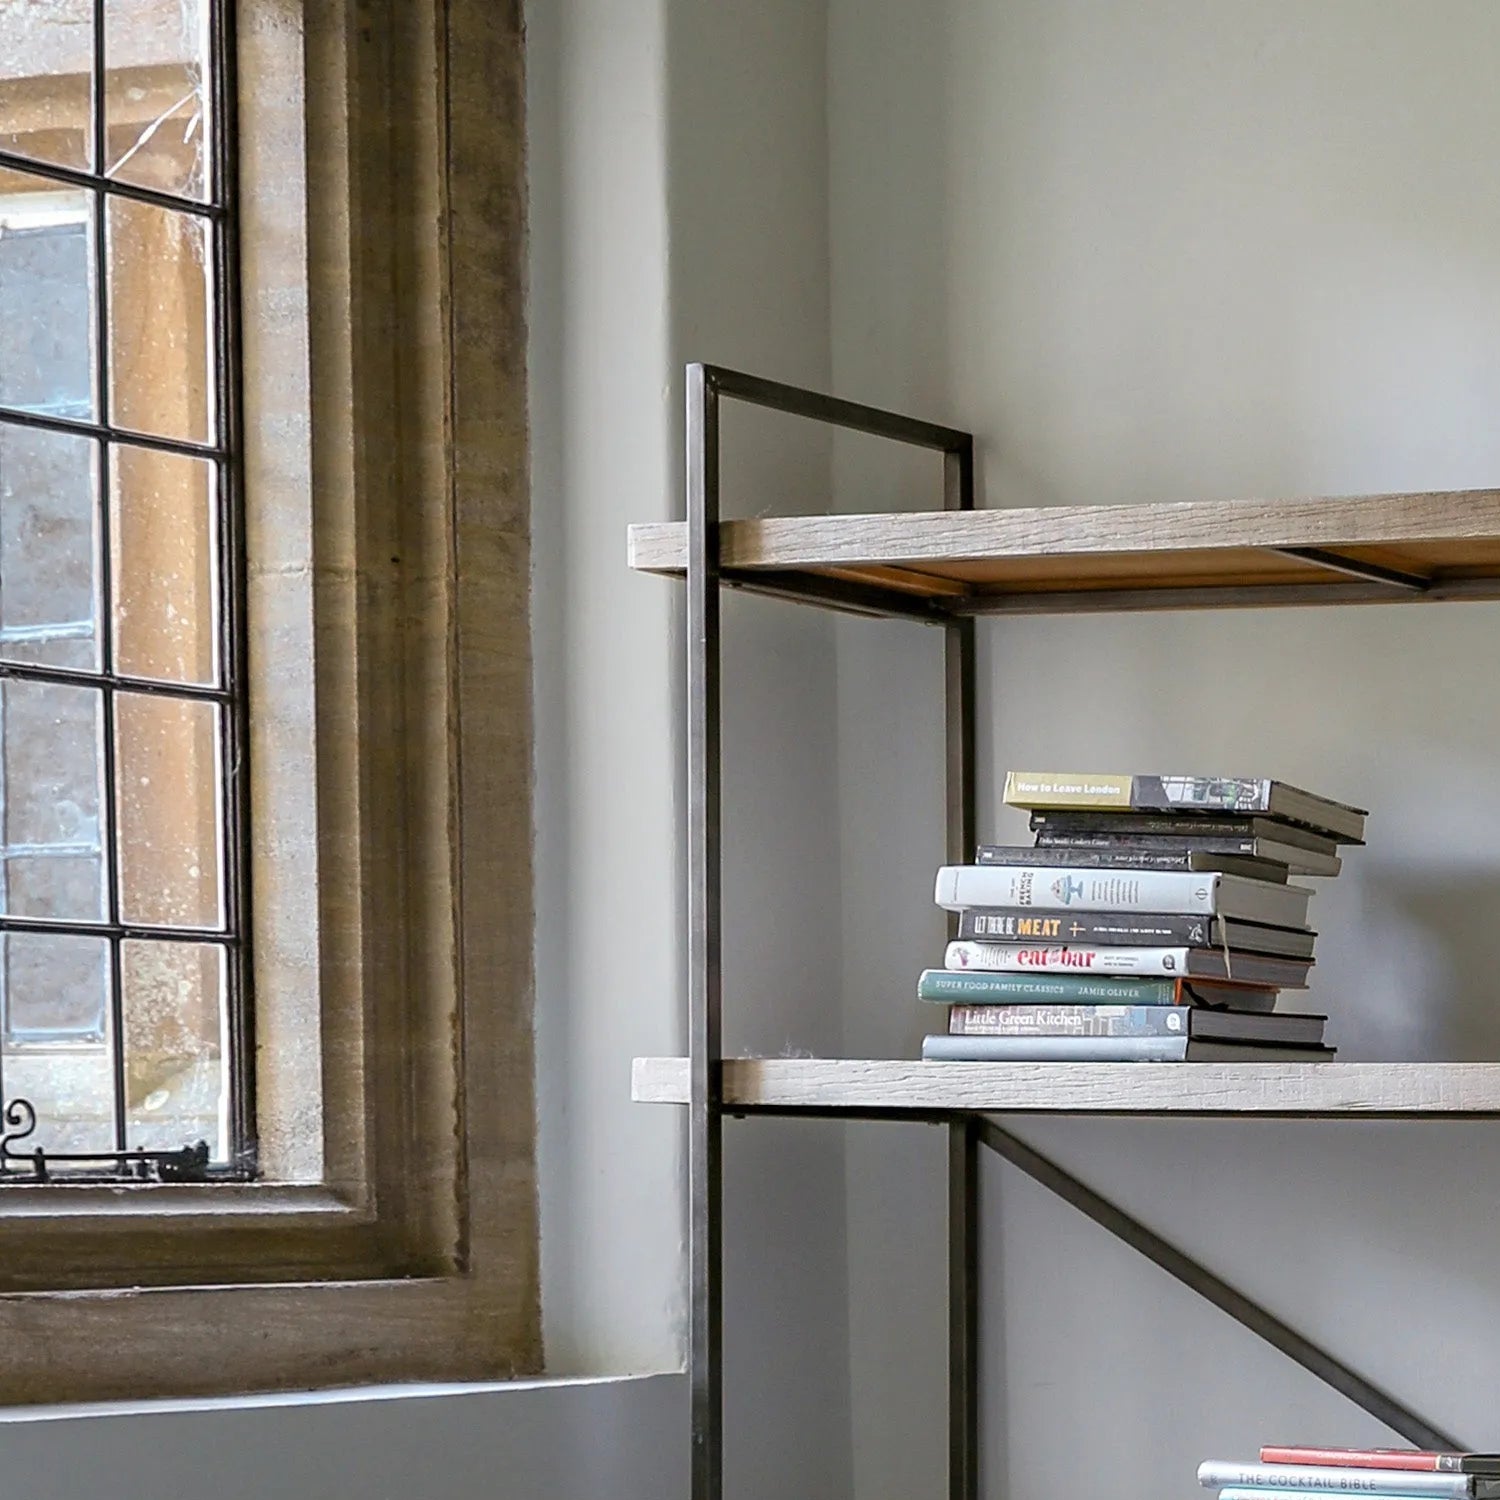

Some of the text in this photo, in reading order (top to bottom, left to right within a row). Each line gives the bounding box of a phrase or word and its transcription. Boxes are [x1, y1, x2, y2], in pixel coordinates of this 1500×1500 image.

[1016, 782, 1121, 795] How to Leave London
[1019, 872, 1027, 906] FRENCH
[1026, 872, 1034, 906] BAKING
[1016, 918, 1061, 937] MEAT
[1017, 948, 1049, 967] eat
[1061, 945, 1096, 968] bar
[935, 980, 1065, 994] SUPER FOOD FAMILY CLASSICS
[1077, 987, 1140, 998] JAMIE OLIVER
[965, 1009, 1082, 1027] Little Green Kitchen
[1238, 1472, 1377, 1491] THE COCKTAIL BIBLE
